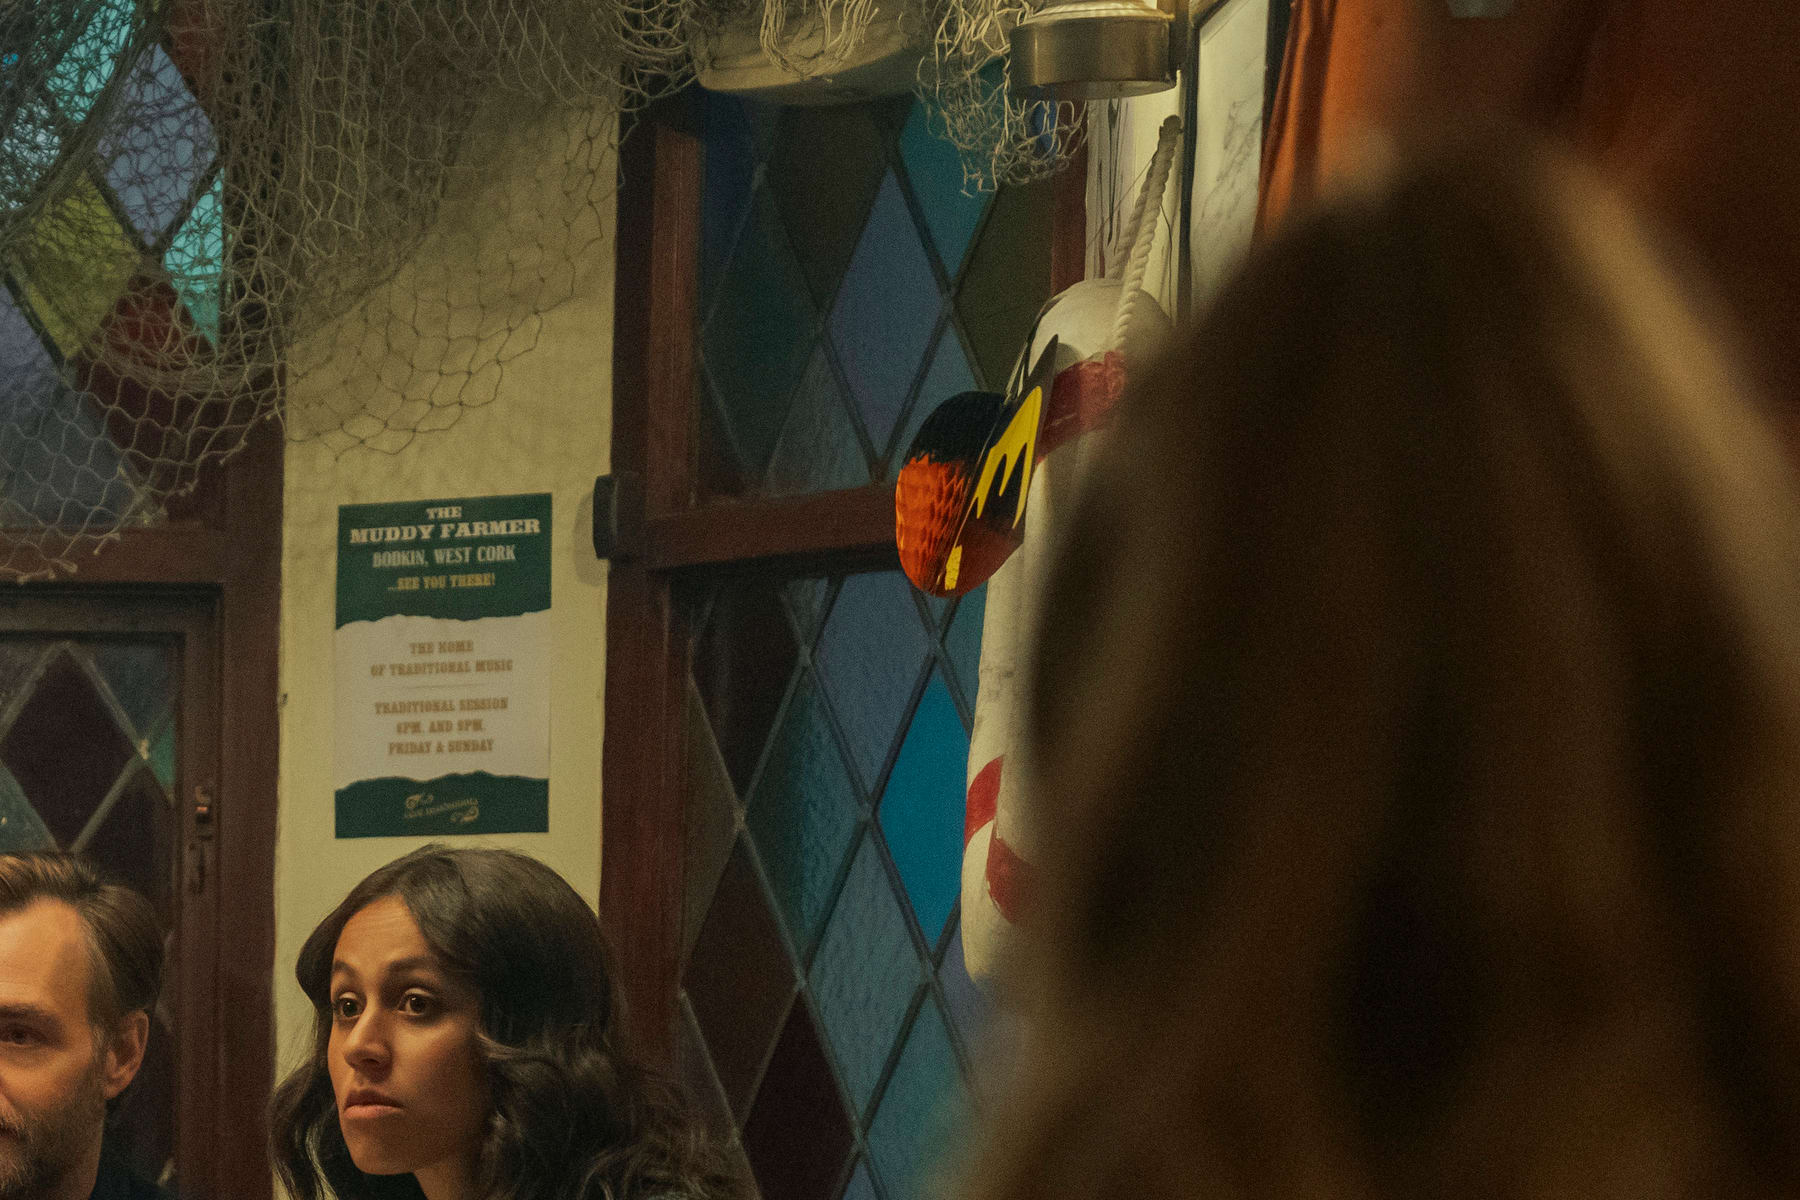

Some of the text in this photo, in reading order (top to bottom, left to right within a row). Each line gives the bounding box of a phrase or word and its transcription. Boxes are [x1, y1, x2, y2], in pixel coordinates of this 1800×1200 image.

[426, 506, 462, 520] THE
[349, 518, 540, 544] MUDDY FARMER
[434, 546, 472, 565] WEST
[477, 544, 516, 562] CORK
[423, 575, 447, 590] YOU
[449, 572, 496, 588] THERE!
[410, 640, 474, 655] THE HOME
[370, 659, 513, 677] OF TRADITIONAL MUSIC
[375, 697, 509, 715] TRADITIONAL SESSION
[429, 719, 453, 733] AND
[388, 738, 495, 755] FRIDAY & SUNDAY
